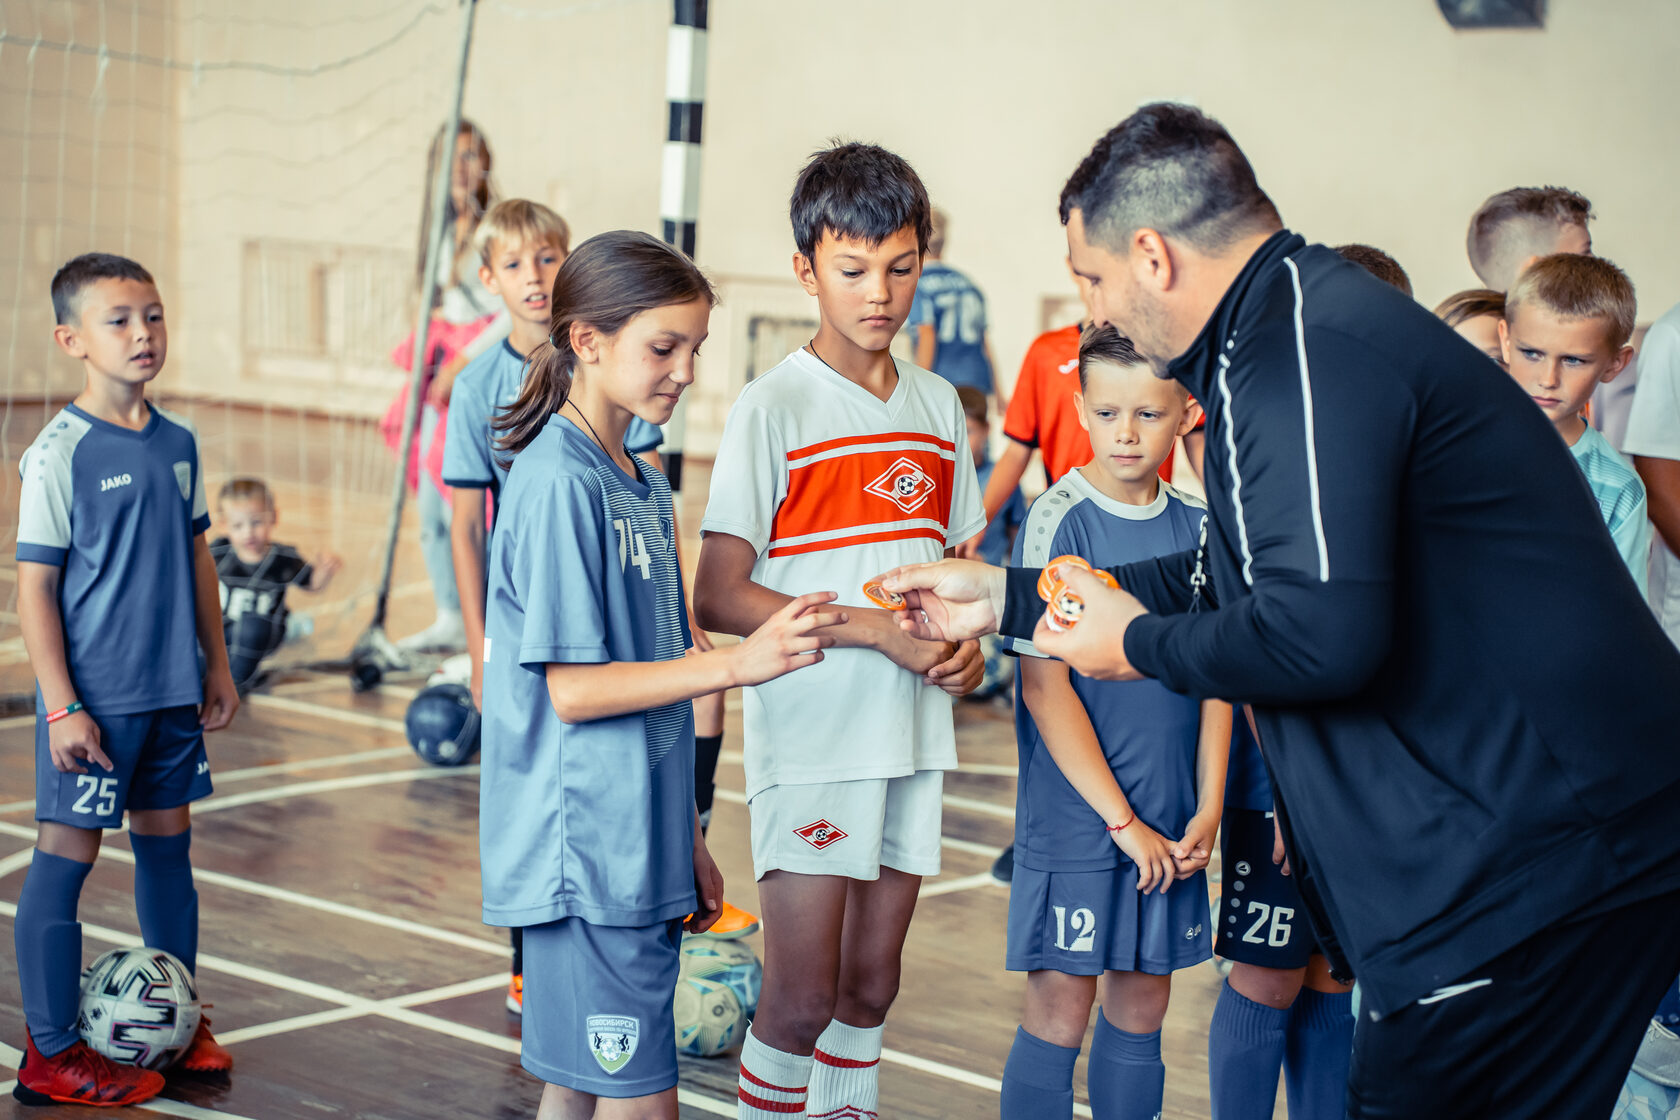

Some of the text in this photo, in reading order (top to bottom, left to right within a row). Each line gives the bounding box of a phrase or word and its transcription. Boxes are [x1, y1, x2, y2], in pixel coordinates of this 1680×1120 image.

[101, 473, 132, 492] JAKO
[613, 517, 652, 580] 74
[72, 774, 118, 816] 25
[1052, 905, 1096, 952] 12
[1242, 901, 1295, 947] 26
